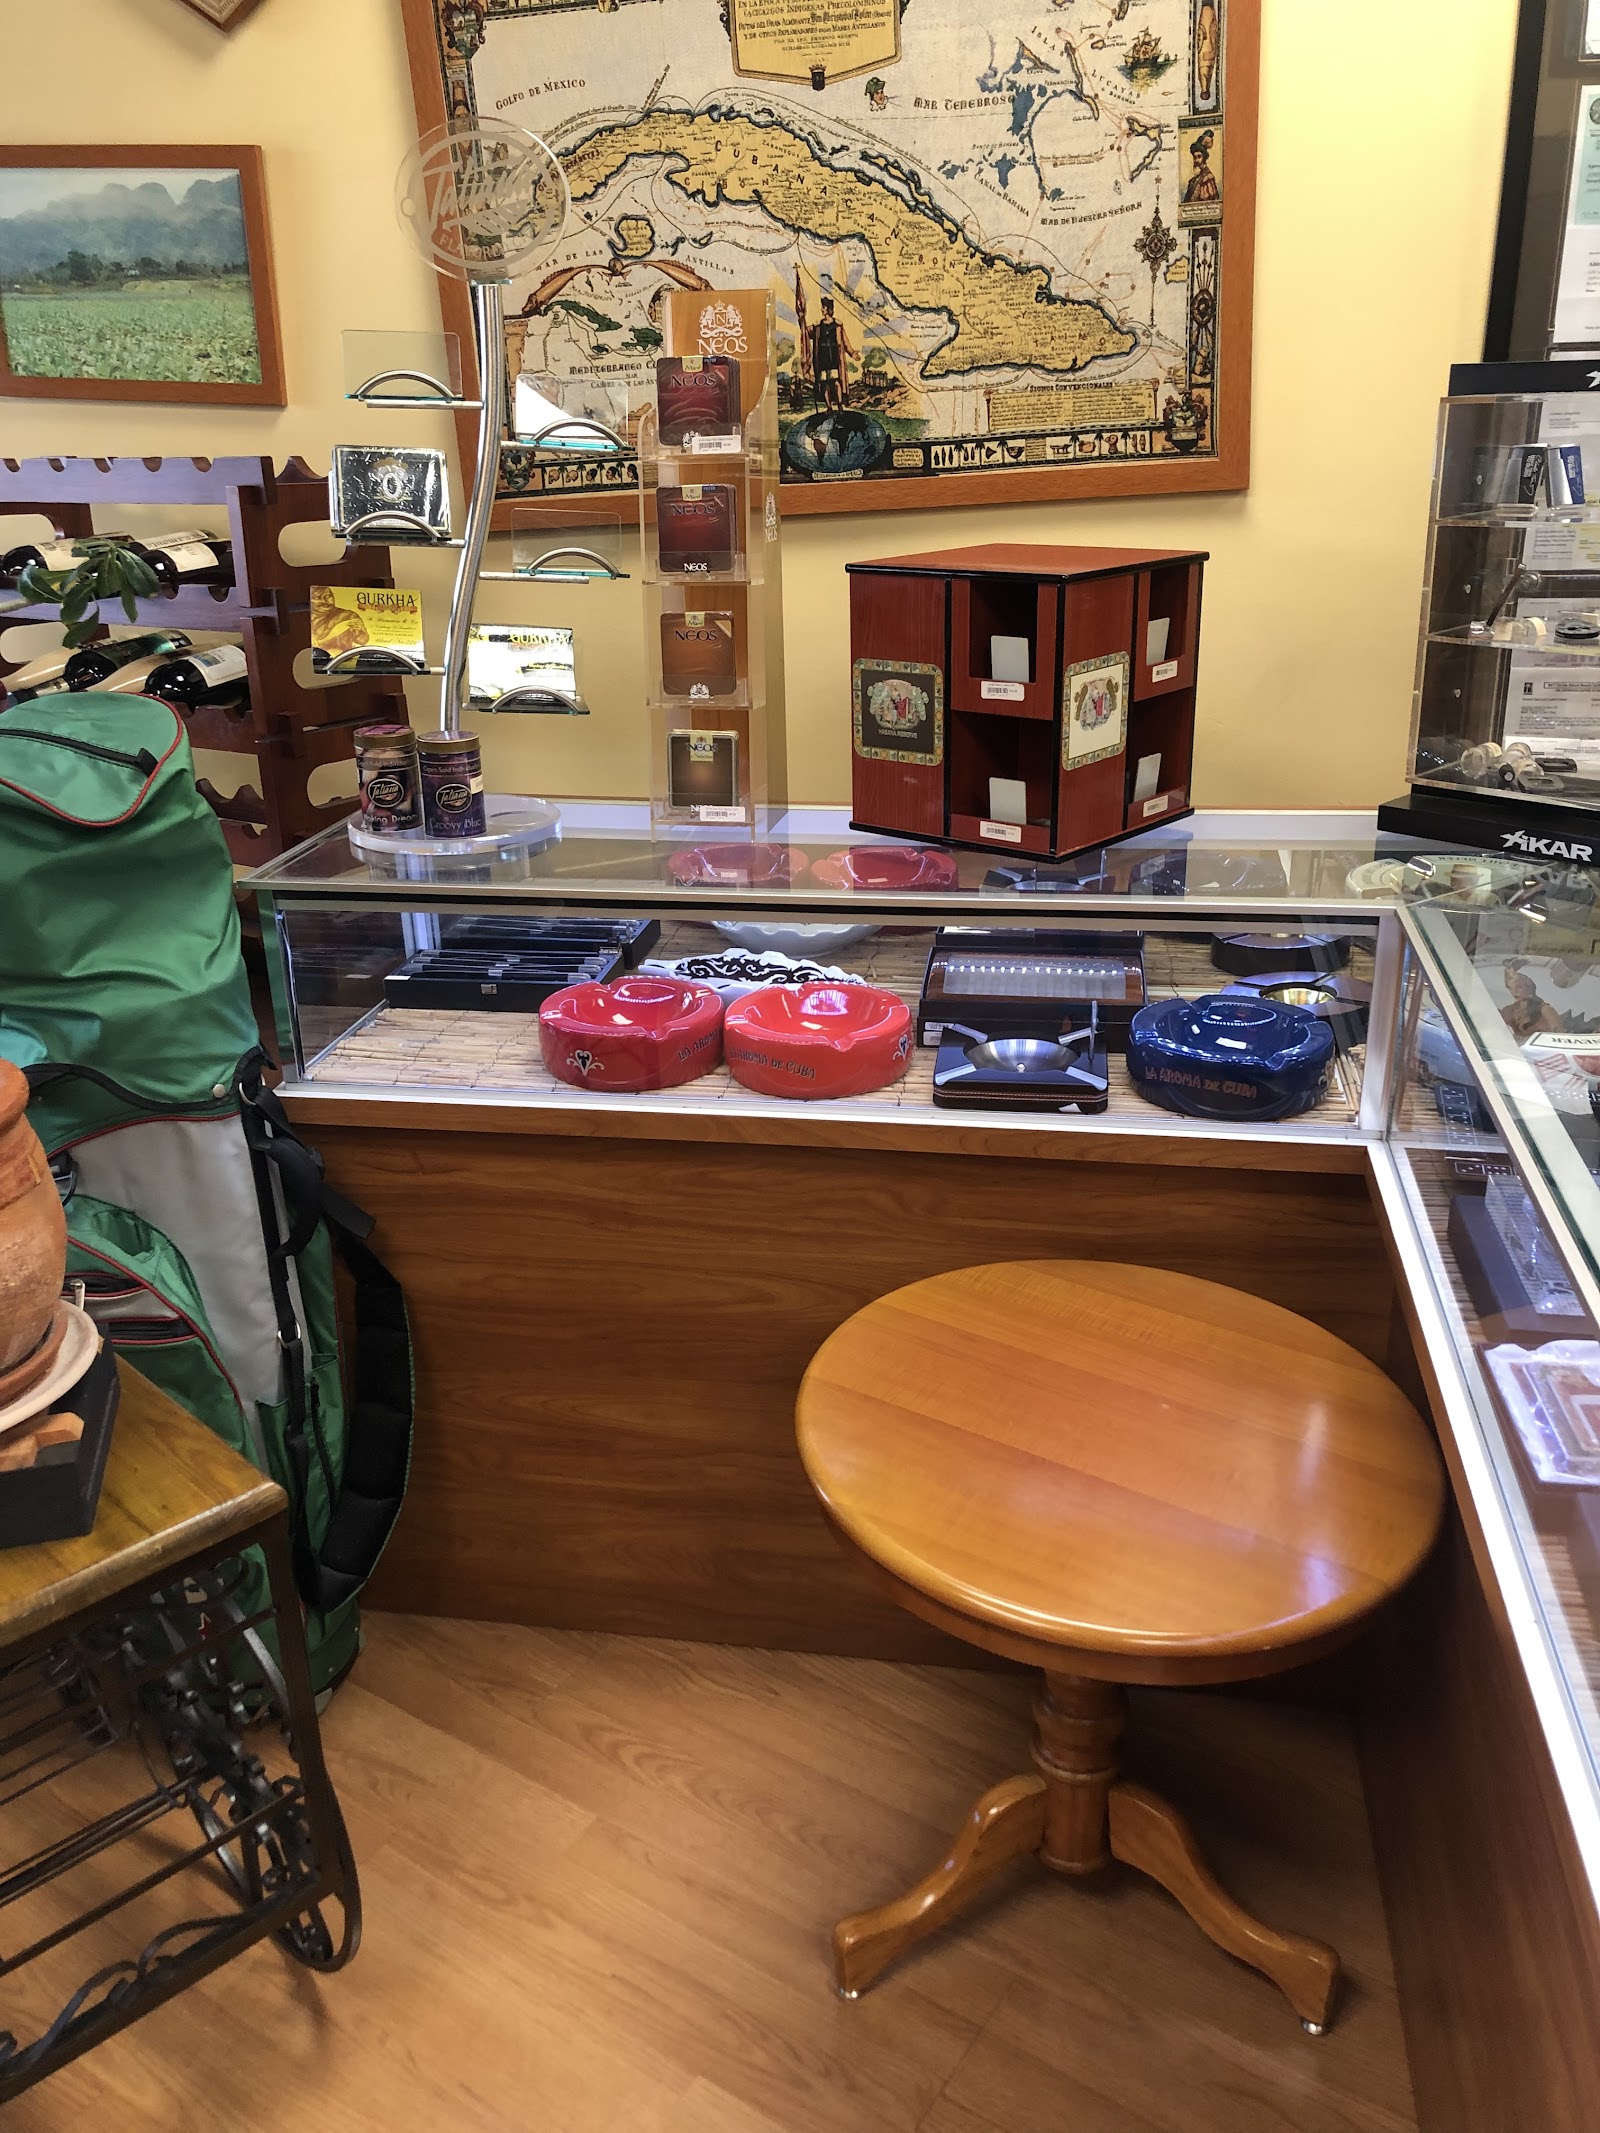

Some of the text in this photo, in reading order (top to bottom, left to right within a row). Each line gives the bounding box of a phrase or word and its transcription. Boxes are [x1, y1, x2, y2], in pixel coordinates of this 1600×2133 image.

[495, 79, 587, 111] GOLFO DE MEXICO
[535, 249, 736, 275] MAR DE LAS ANTILLAS
[697, 336, 748, 354] NEOS
[670, 373, 717, 387] NEOS
[1029, 382, 1114, 393] SIGNOS CONVENCIONALES
[671, 503, 716, 517] NEOS
[683, 562, 708, 572] NEOS
[356, 591, 418, 607] GURKHA
[675, 629, 718, 641] NEOS
[429, 818, 482, 832] Groovy Blue
[738, 1049, 769, 1066] AROMA
[771, 1058, 783, 1069] DE
[786, 1060, 816, 1080] CUBA
[1145, 1066, 1258, 1099] LA AROMA DE CUBA
